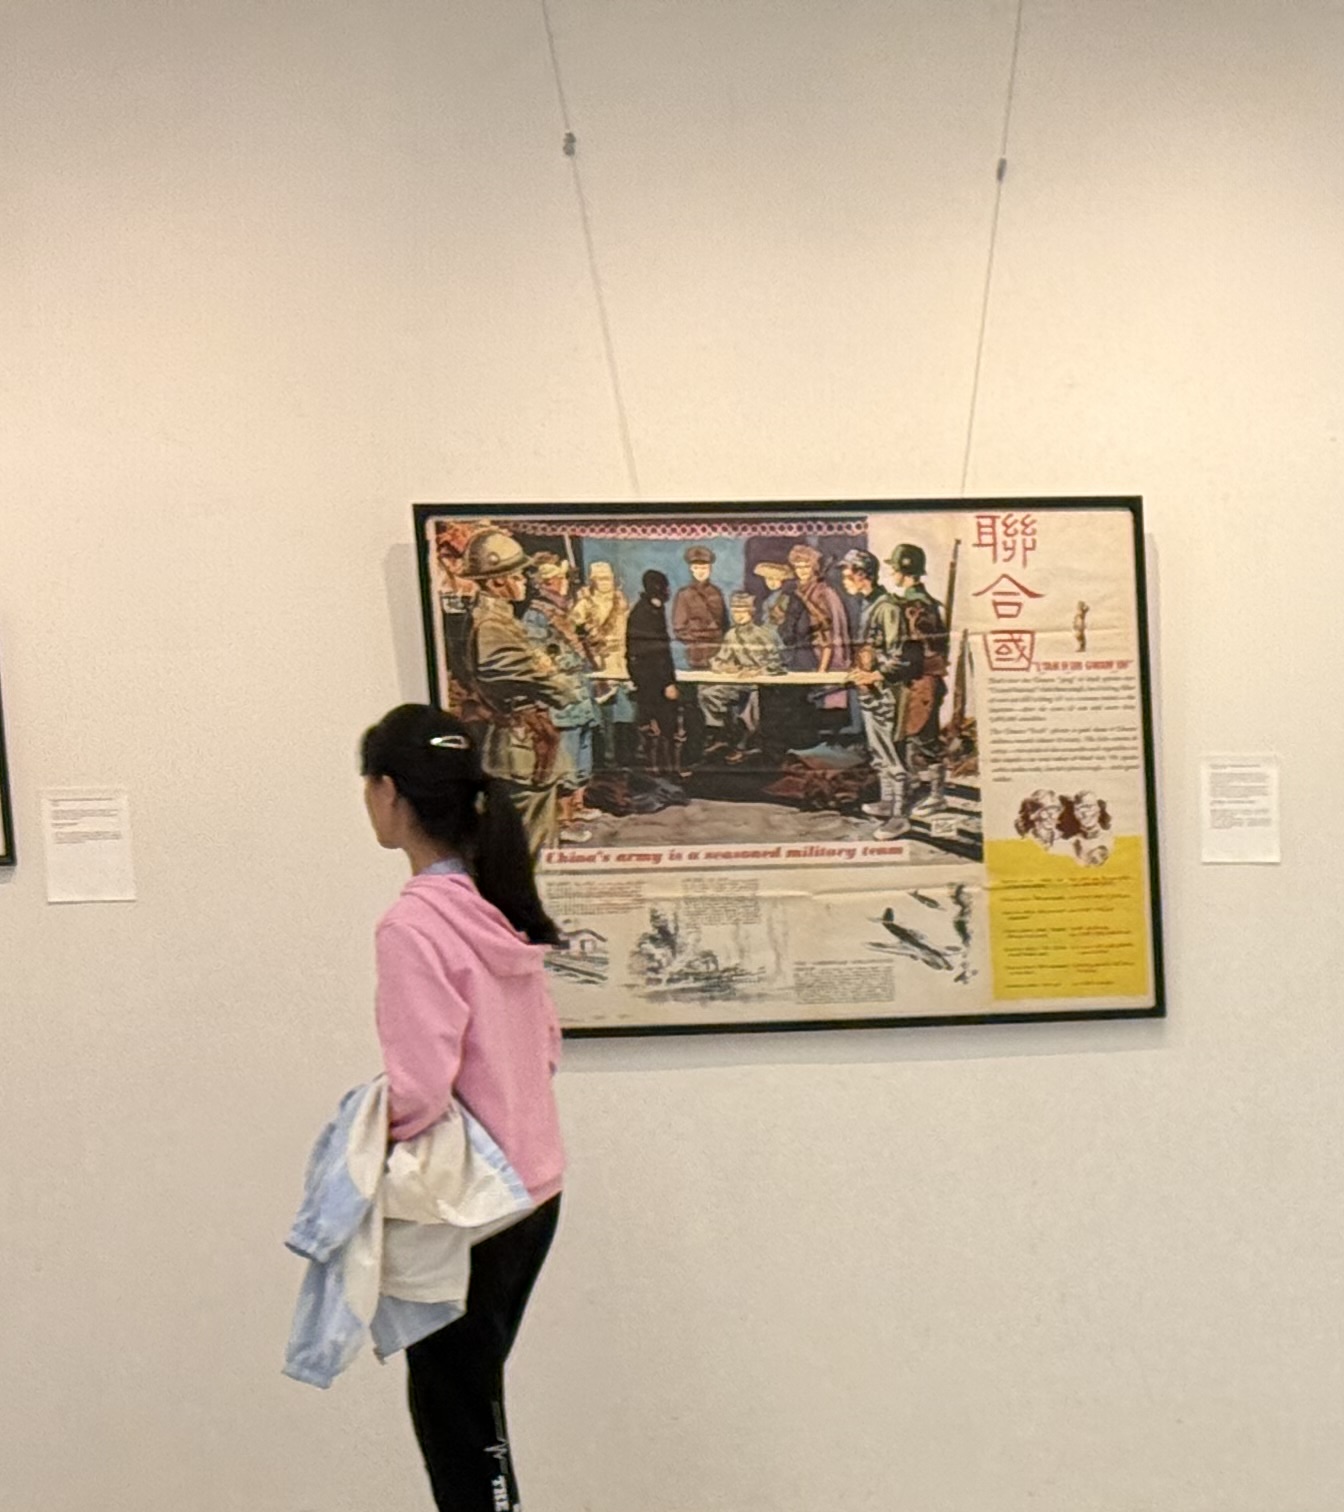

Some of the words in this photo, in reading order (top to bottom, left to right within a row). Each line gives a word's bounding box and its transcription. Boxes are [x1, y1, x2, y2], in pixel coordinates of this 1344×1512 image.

[972, 513, 1045, 672] 聯合國
[545, 851, 610, 864] China's
[616, 851, 664, 864] army
[668, 849, 682, 861] is
[687, 851, 699, 861] a
[704, 847, 781, 860] seasoned
[785, 845, 858, 860] military
[862, 845, 904, 856] team
[491, 1475, 509, 1512] THE
